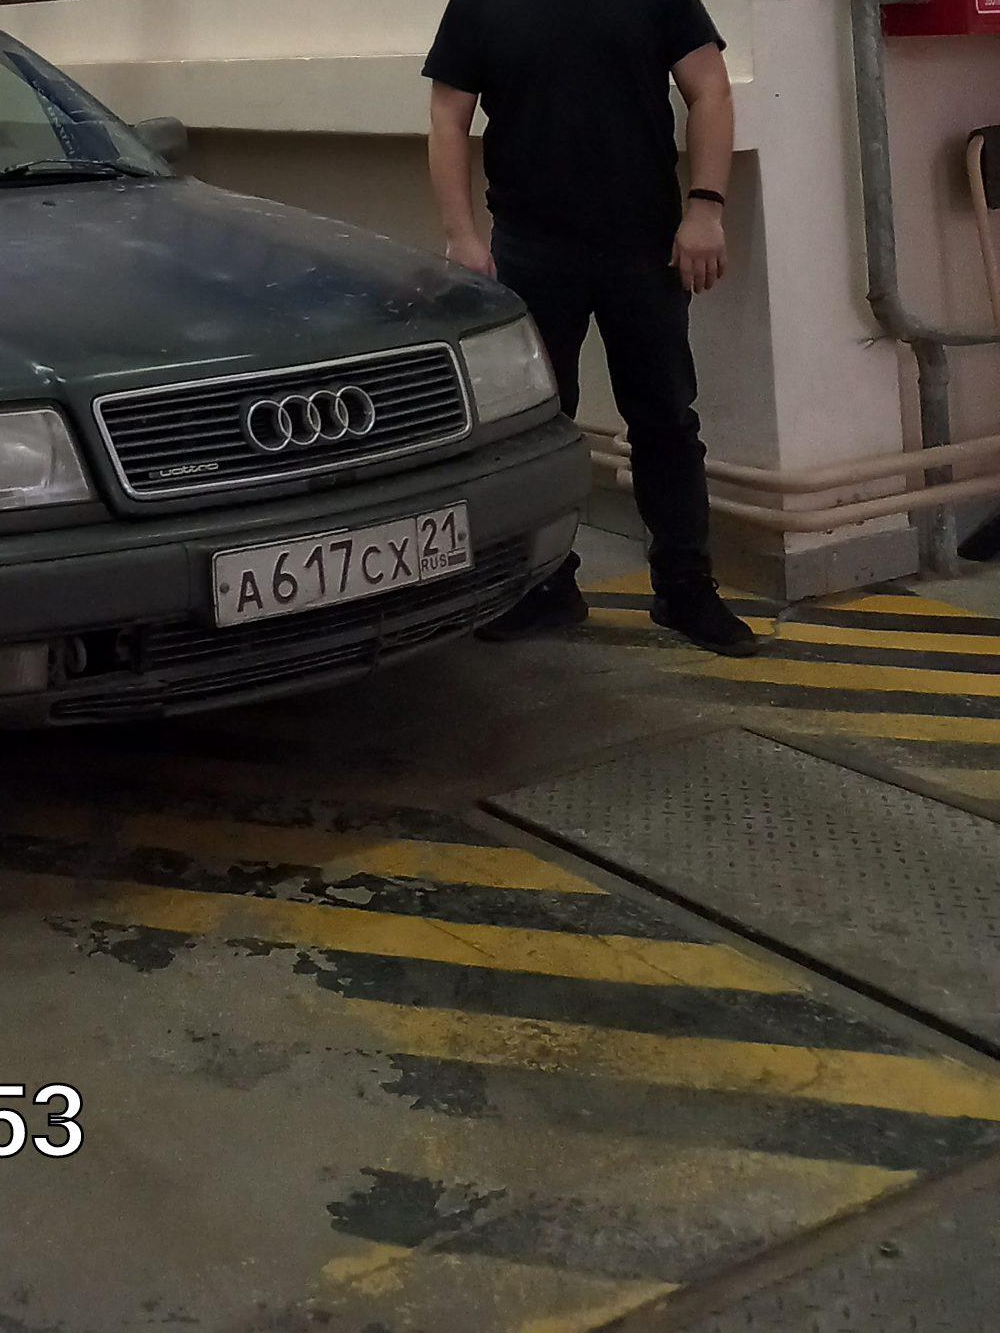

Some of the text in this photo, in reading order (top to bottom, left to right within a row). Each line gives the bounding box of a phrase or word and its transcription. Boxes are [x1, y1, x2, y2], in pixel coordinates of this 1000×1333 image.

[237, 511, 457, 613] А617СХ 21
[421, 552, 448, 573] RUS
